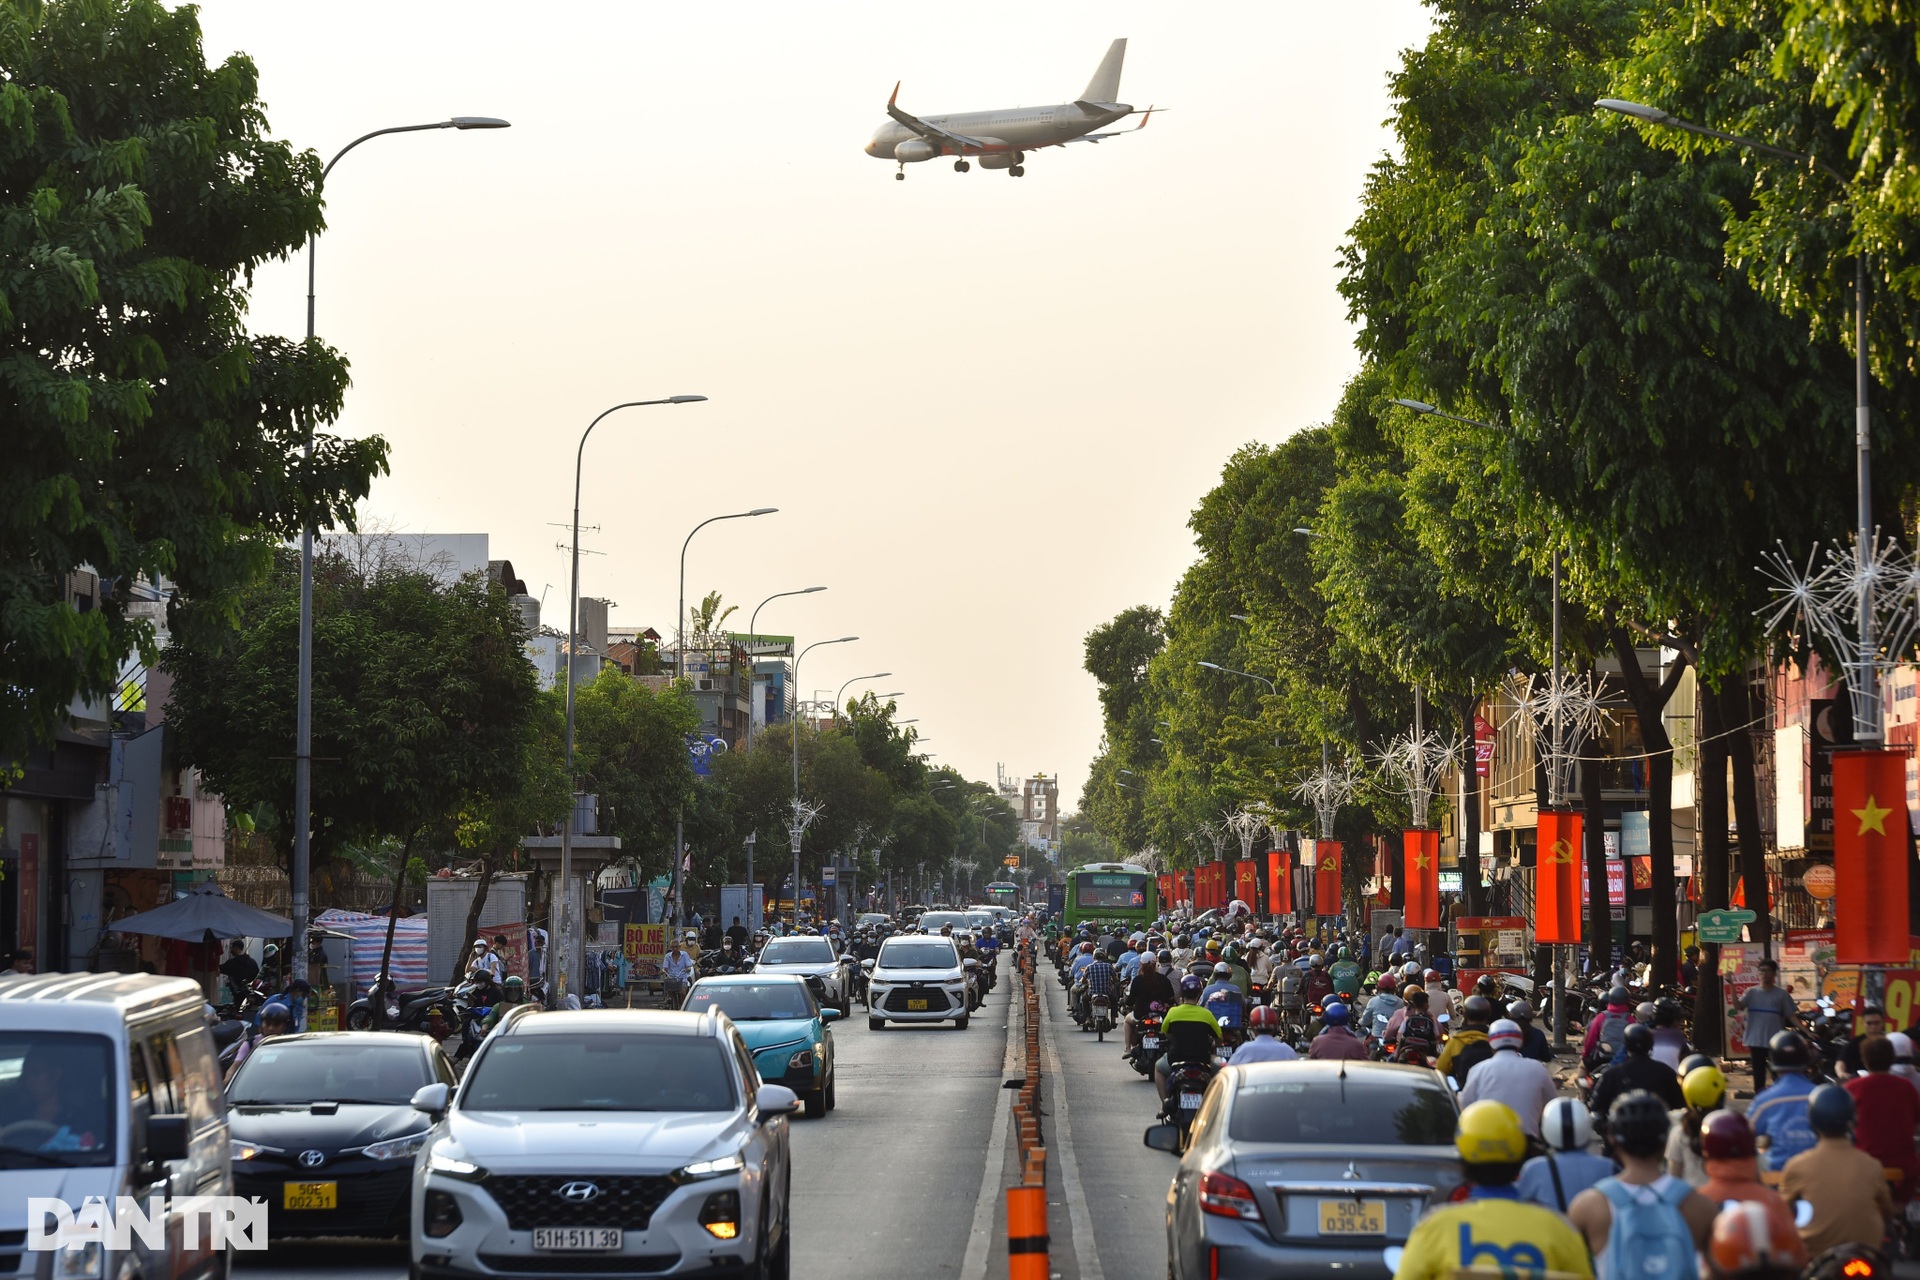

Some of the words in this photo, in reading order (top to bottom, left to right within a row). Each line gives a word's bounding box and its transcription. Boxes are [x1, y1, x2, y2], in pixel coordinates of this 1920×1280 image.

[1812, 796, 1834, 809] IPH
[1822, 818, 1834, 831] IP
[1132, 893, 1143, 904] 24
[626, 926, 643, 943] BÒ
[626, 944, 633, 954] 3
[635, 944, 664, 955] NGON
[299, 1184, 322, 1195] 50E
[289, 1196, 330, 1208] 002.31
[1338, 1203, 1366, 1217] 50E
[1326, 1218, 1379, 1231] 035.45
[536, 1229, 619, 1248] 51H-511.39
